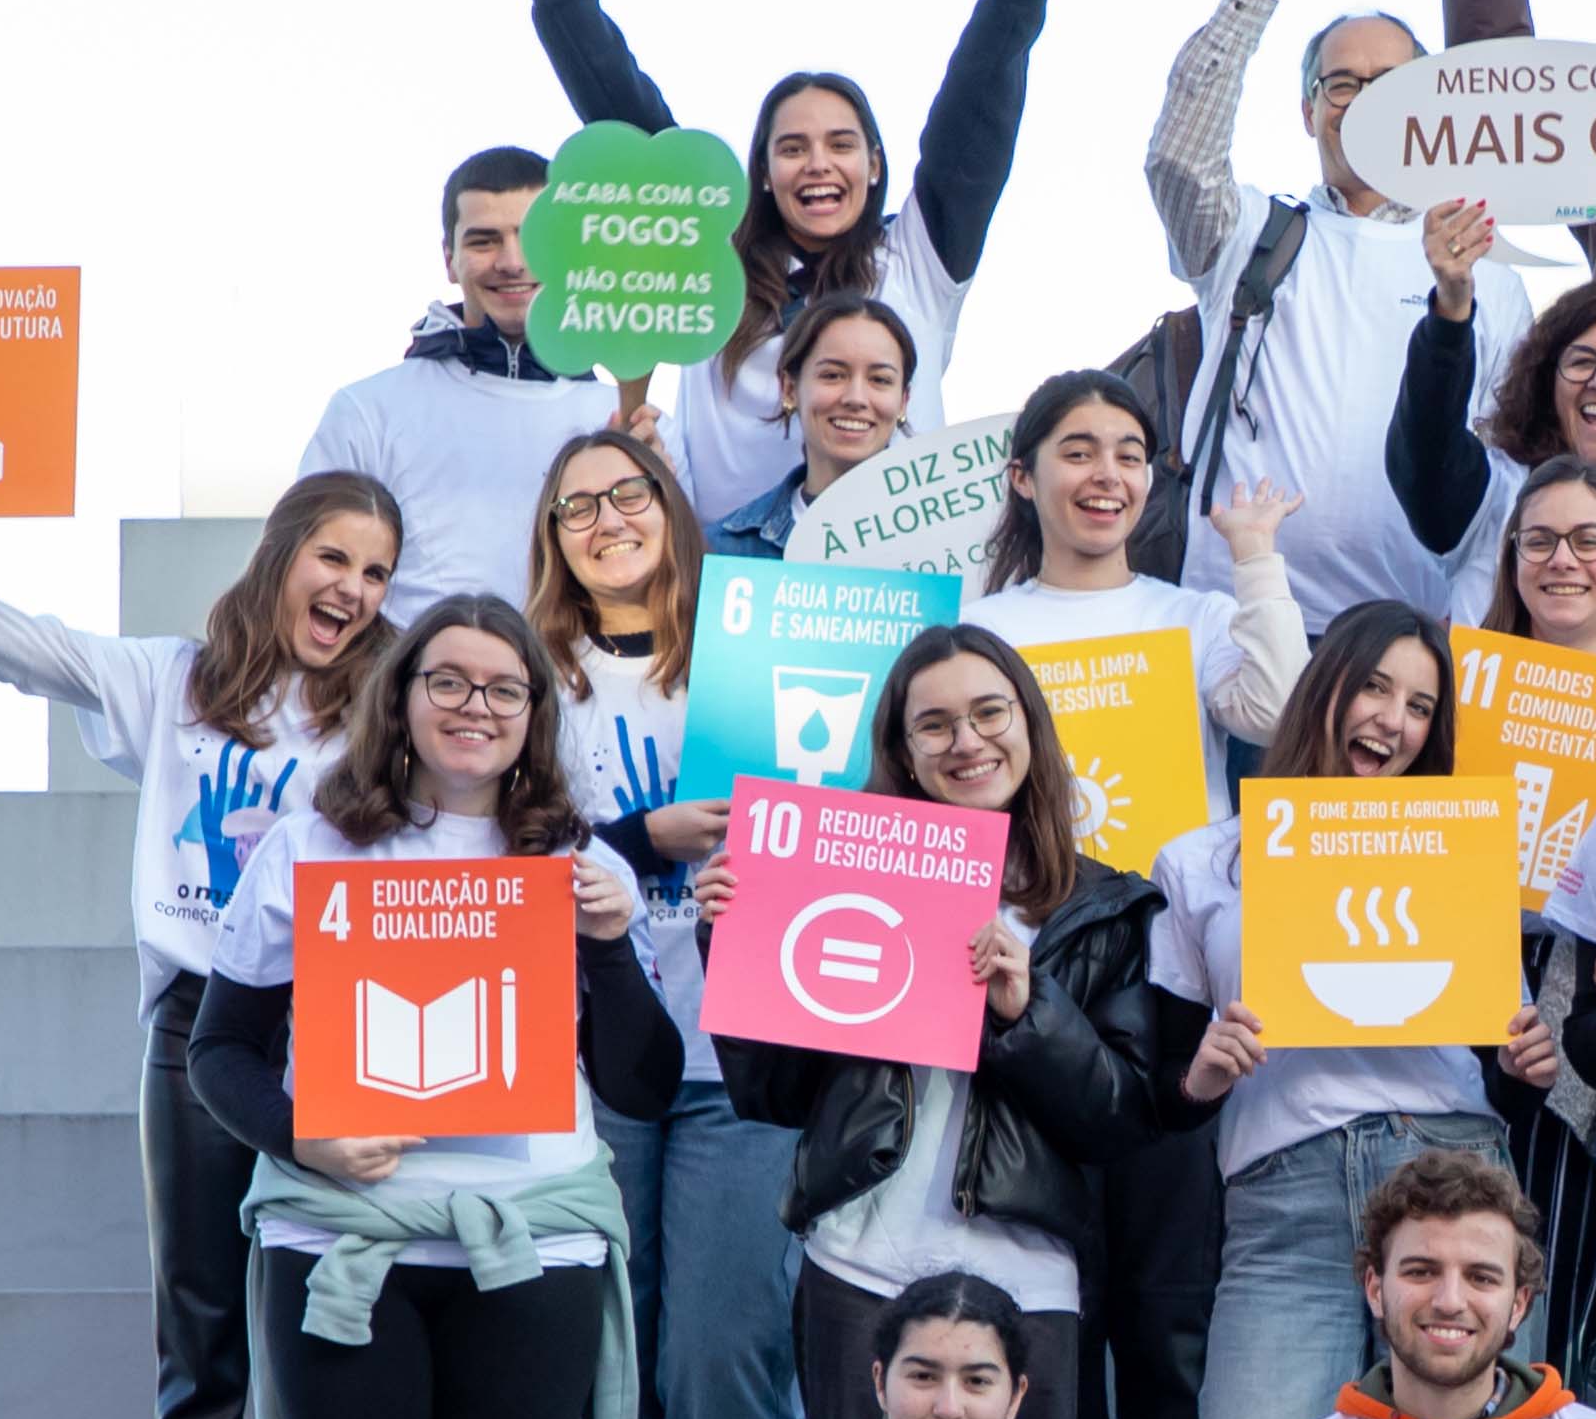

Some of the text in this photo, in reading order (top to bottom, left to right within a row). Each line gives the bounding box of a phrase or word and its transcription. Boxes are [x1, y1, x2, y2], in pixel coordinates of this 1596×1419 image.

[1436, 67, 1557, 95] MENOS
[1403, 111, 1566, 166] MAIS
[551, 181, 731, 207] ACABA COM OS
[580, 214, 700, 247] FOGOS
[565, 266, 712, 294] NÃO COM AS
[559, 294, 715, 334] ÁRVORES
[883, 452, 945, 497] DIZ
[822, 474, 1005, 559] À FLOREST
[722, 577, 753, 635] 6
[772, 576, 922, 617] ÁGUA POTÁVEL
[770, 612, 785, 638] E
[1089, 651, 1148, 680] LIMPA
[1460, 648, 1502, 710] 11
[1514, 661, 1595, 699] CIDADES
[1266, 798, 1294, 856] 2
[1310, 799, 1500, 819] FOME ZERO E AGRICULTURA
[748, 798, 802, 859] 10
[818, 807, 967, 853] REDUÇÃO DAS
[1311, 826, 1448, 855] SUSTENTÁVEL
[814, 838, 993, 888] DESIGUALDADES
[177, 884, 189, 898] o
[372, 873, 524, 910] EDUCAÇÃO DE
[154, 901, 220, 926] começa
[318, 881, 351, 942] 4
[372, 911, 497, 941] QUALIDADE
